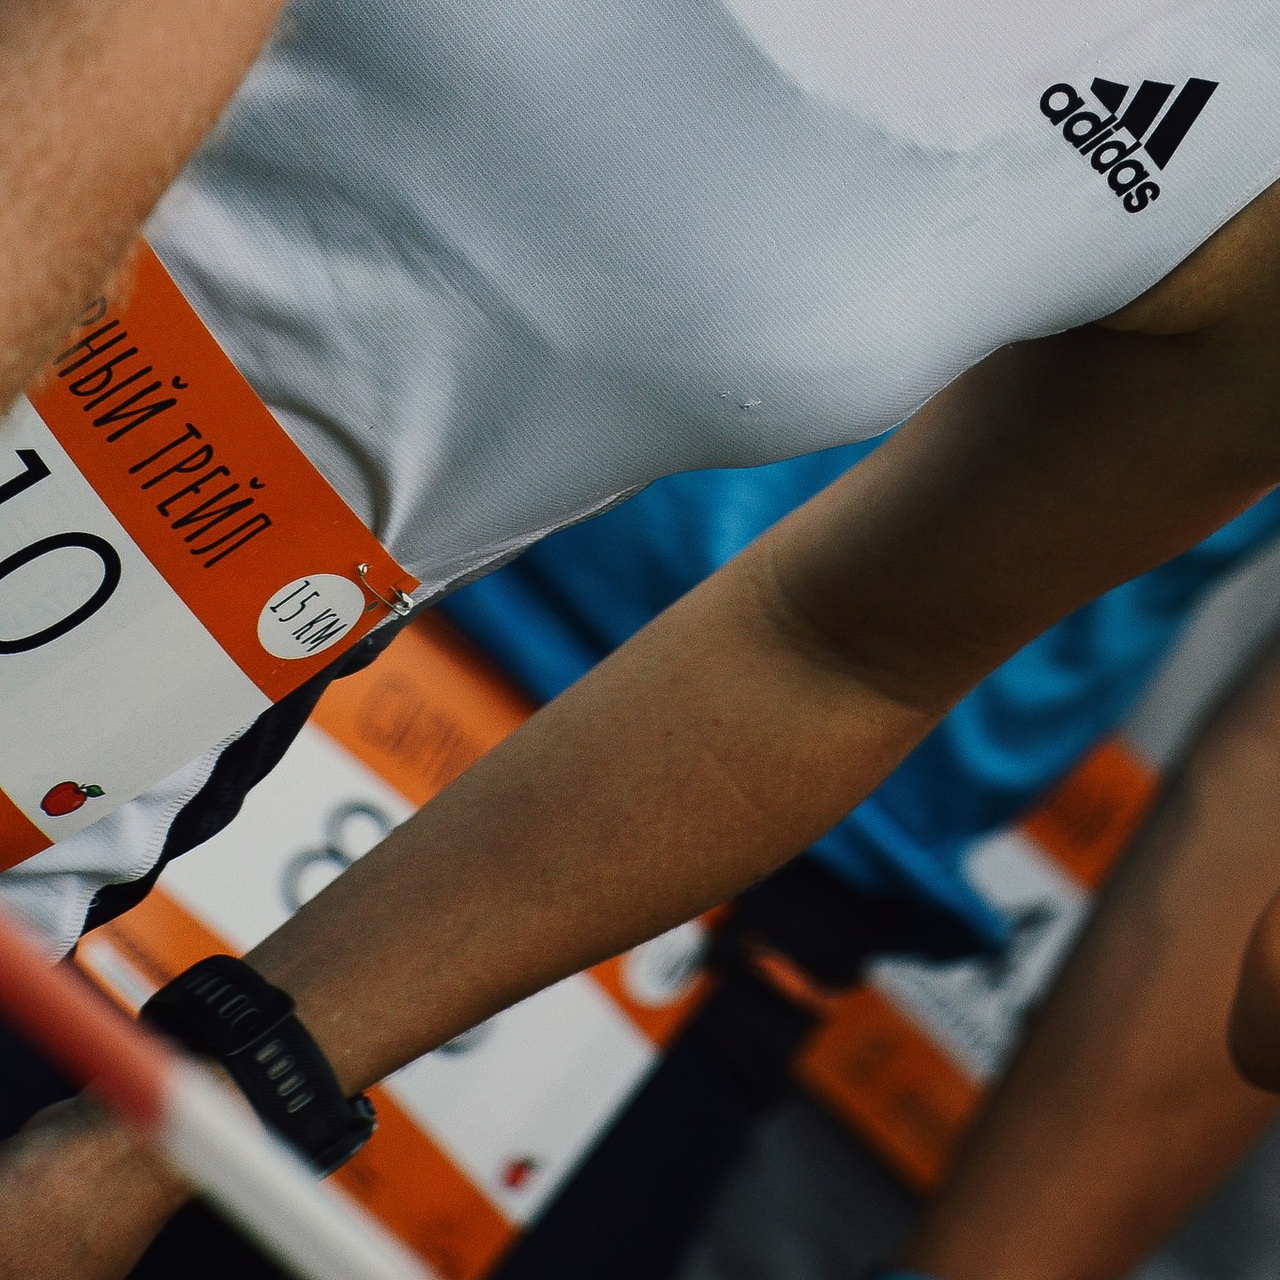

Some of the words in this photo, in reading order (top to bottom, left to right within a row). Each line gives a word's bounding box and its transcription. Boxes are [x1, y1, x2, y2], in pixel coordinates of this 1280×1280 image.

[1040, 82, 1161, 214] adidas
[128, 422, 272, 569] ТРЕЙЛ
[269, 580, 320, 623] 15
[291, 608, 348, 653] КМ
